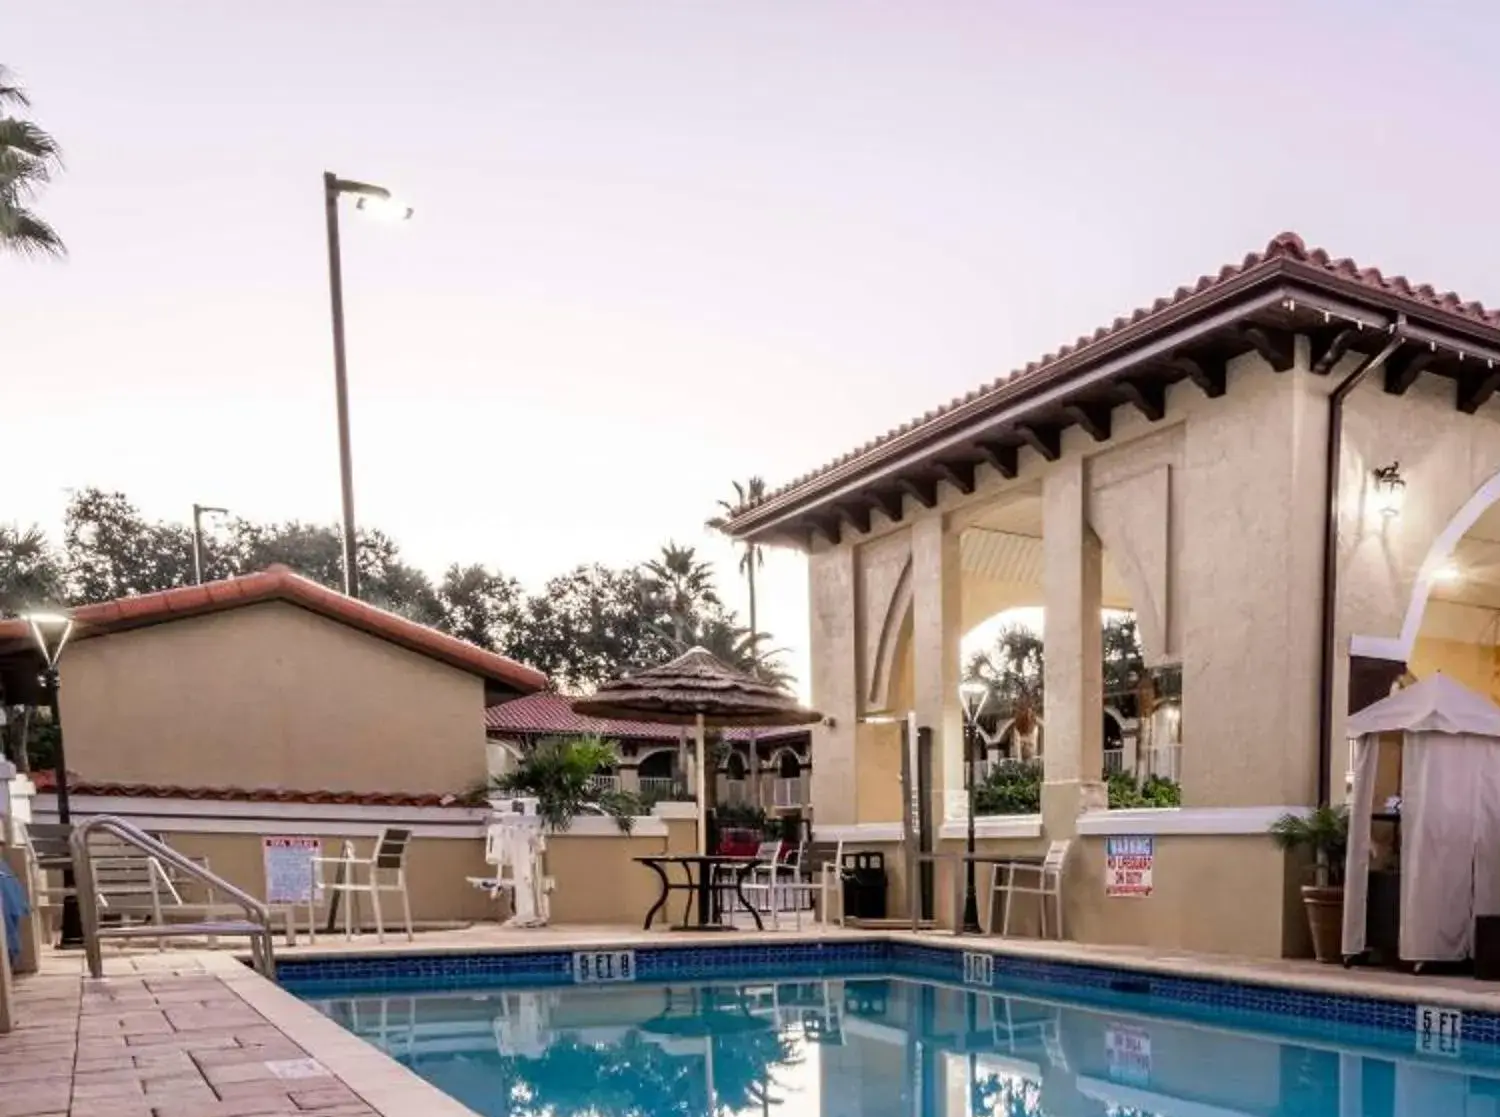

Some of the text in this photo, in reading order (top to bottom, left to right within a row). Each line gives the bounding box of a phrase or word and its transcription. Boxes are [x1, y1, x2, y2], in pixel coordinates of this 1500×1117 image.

[1110, 837, 1150, 854] WARNING
[1107, 856, 1152, 870] NO LIFEGUARD
[1115, 871, 1142, 884] ON DUTY
[1423, 1010, 1458, 1037] 5 FT
